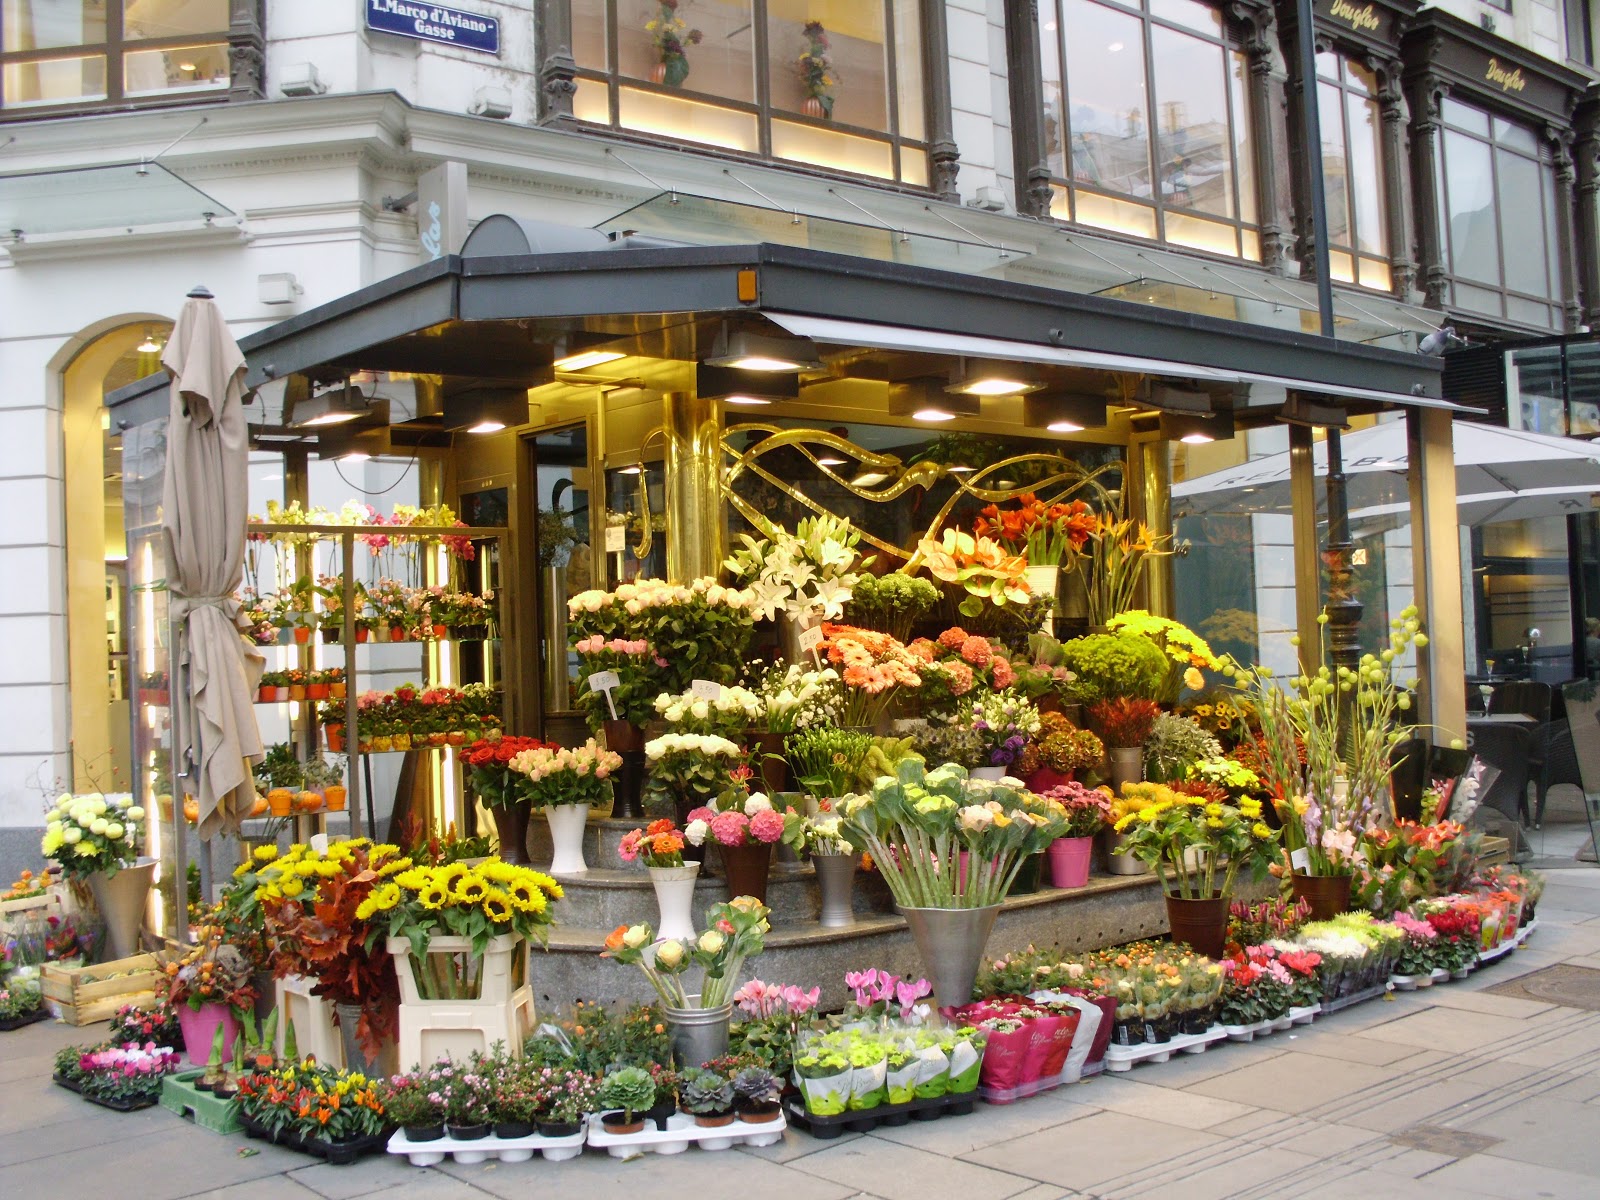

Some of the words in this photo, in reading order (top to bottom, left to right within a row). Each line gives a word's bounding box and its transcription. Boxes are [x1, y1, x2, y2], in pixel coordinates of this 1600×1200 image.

[385, 0, 428, 20] Marco
[1330, 0, 1379, 30] Douglas
[414, 19, 455, 40] Gasse
[1486, 58, 1525, 91] Douglas
